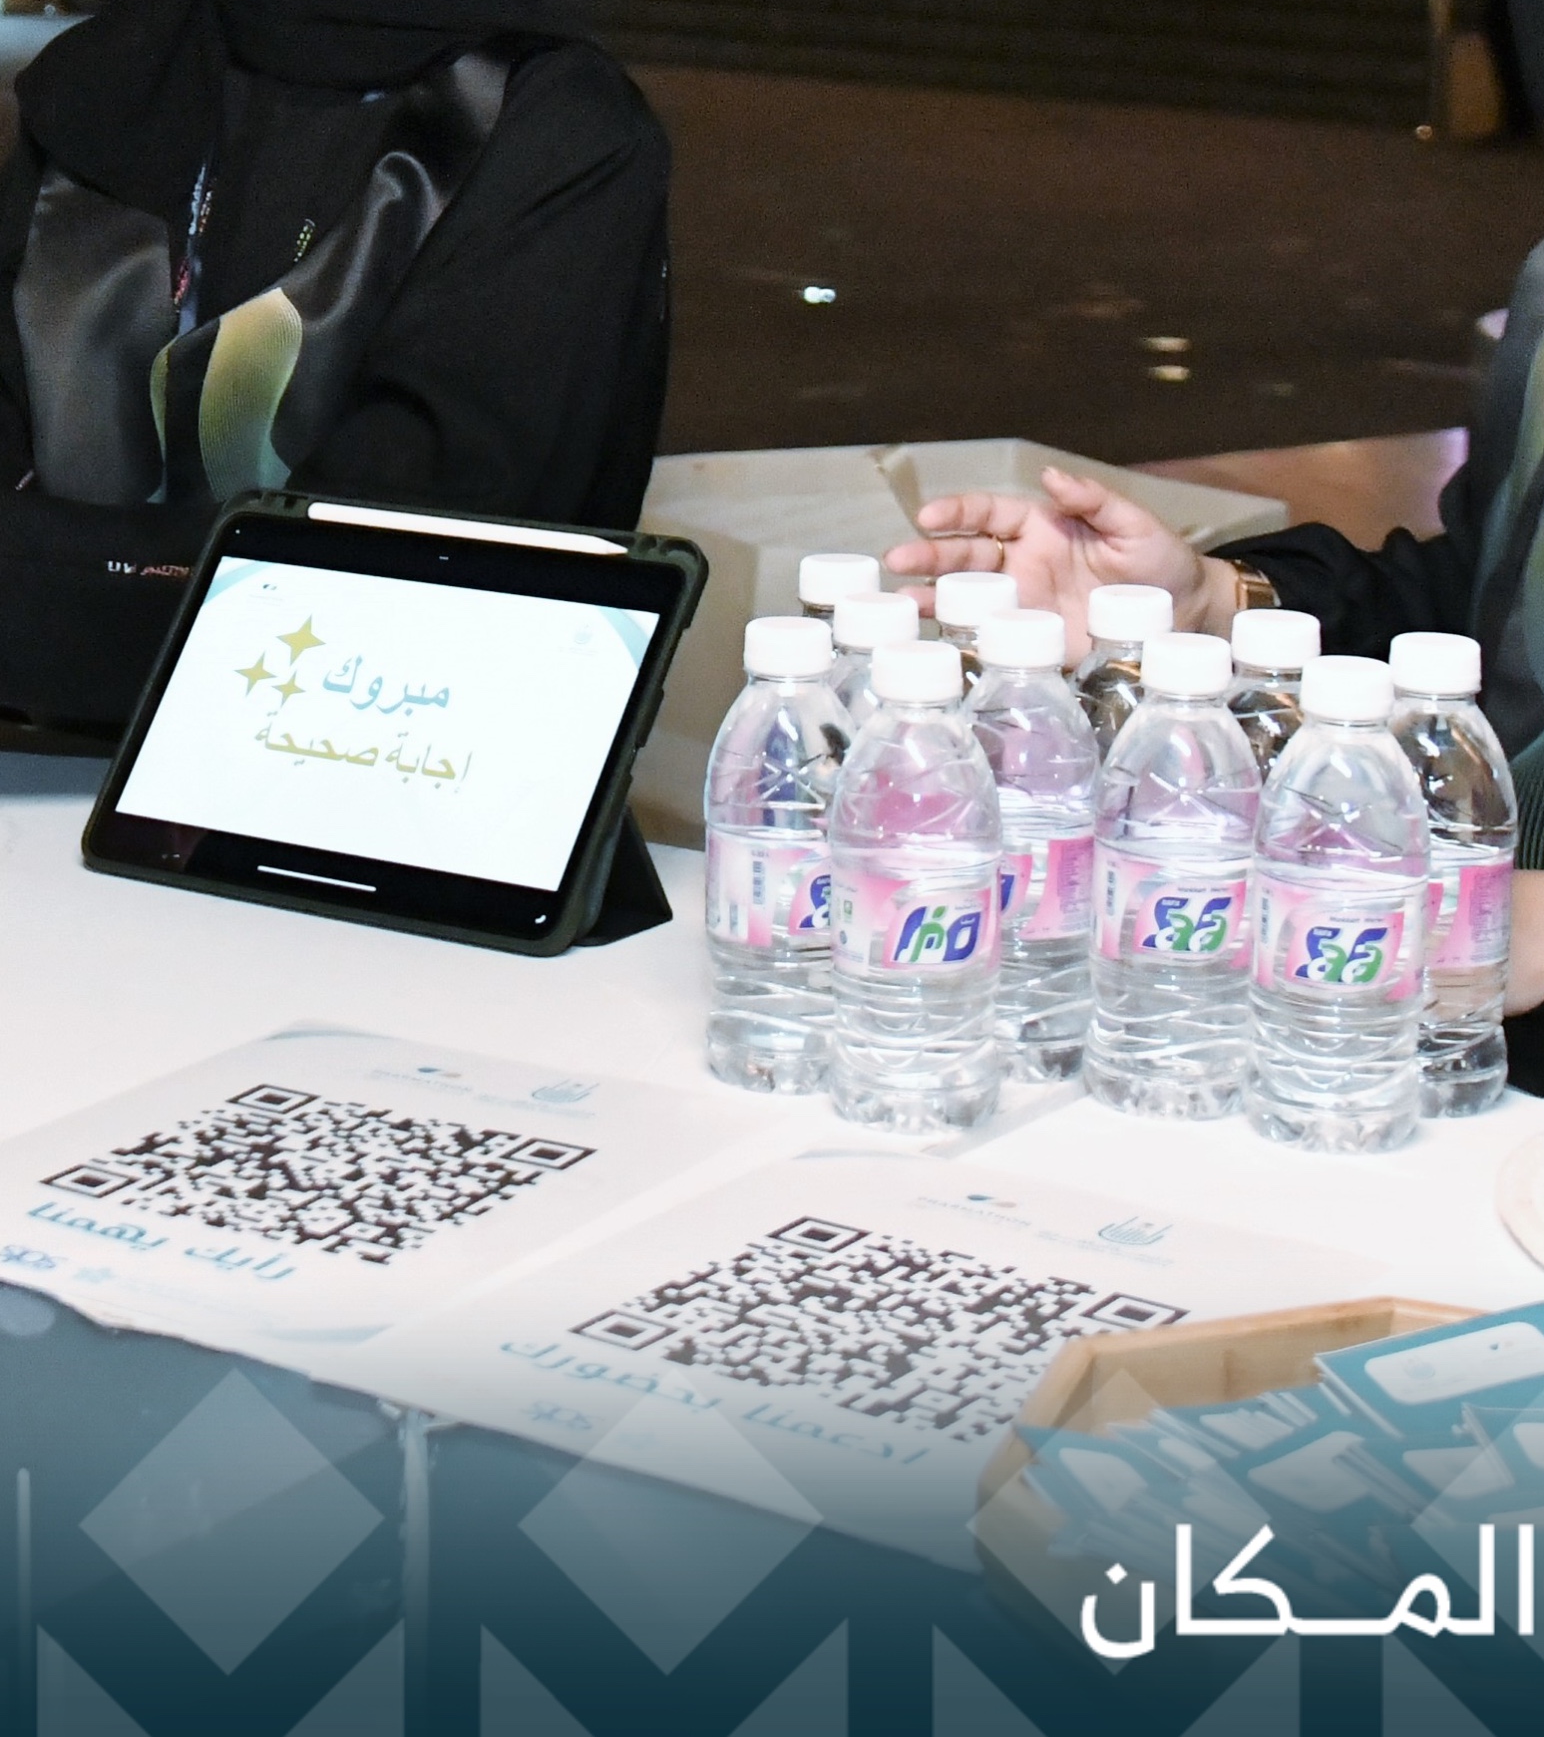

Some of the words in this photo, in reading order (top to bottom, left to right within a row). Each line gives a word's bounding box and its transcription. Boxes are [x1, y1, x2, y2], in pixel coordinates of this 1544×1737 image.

[322, 653, 452, 716] مبروك
[254, 709, 380, 768] صحيحة
[384, 731, 474, 795] إجابة
[26, 1200, 171, 1251] يهمنا
[182, 1245, 298, 1282] رأيك
[498, 1339, 724, 1414] بحضورك
[741, 1400, 932, 1466] ادعمنا
